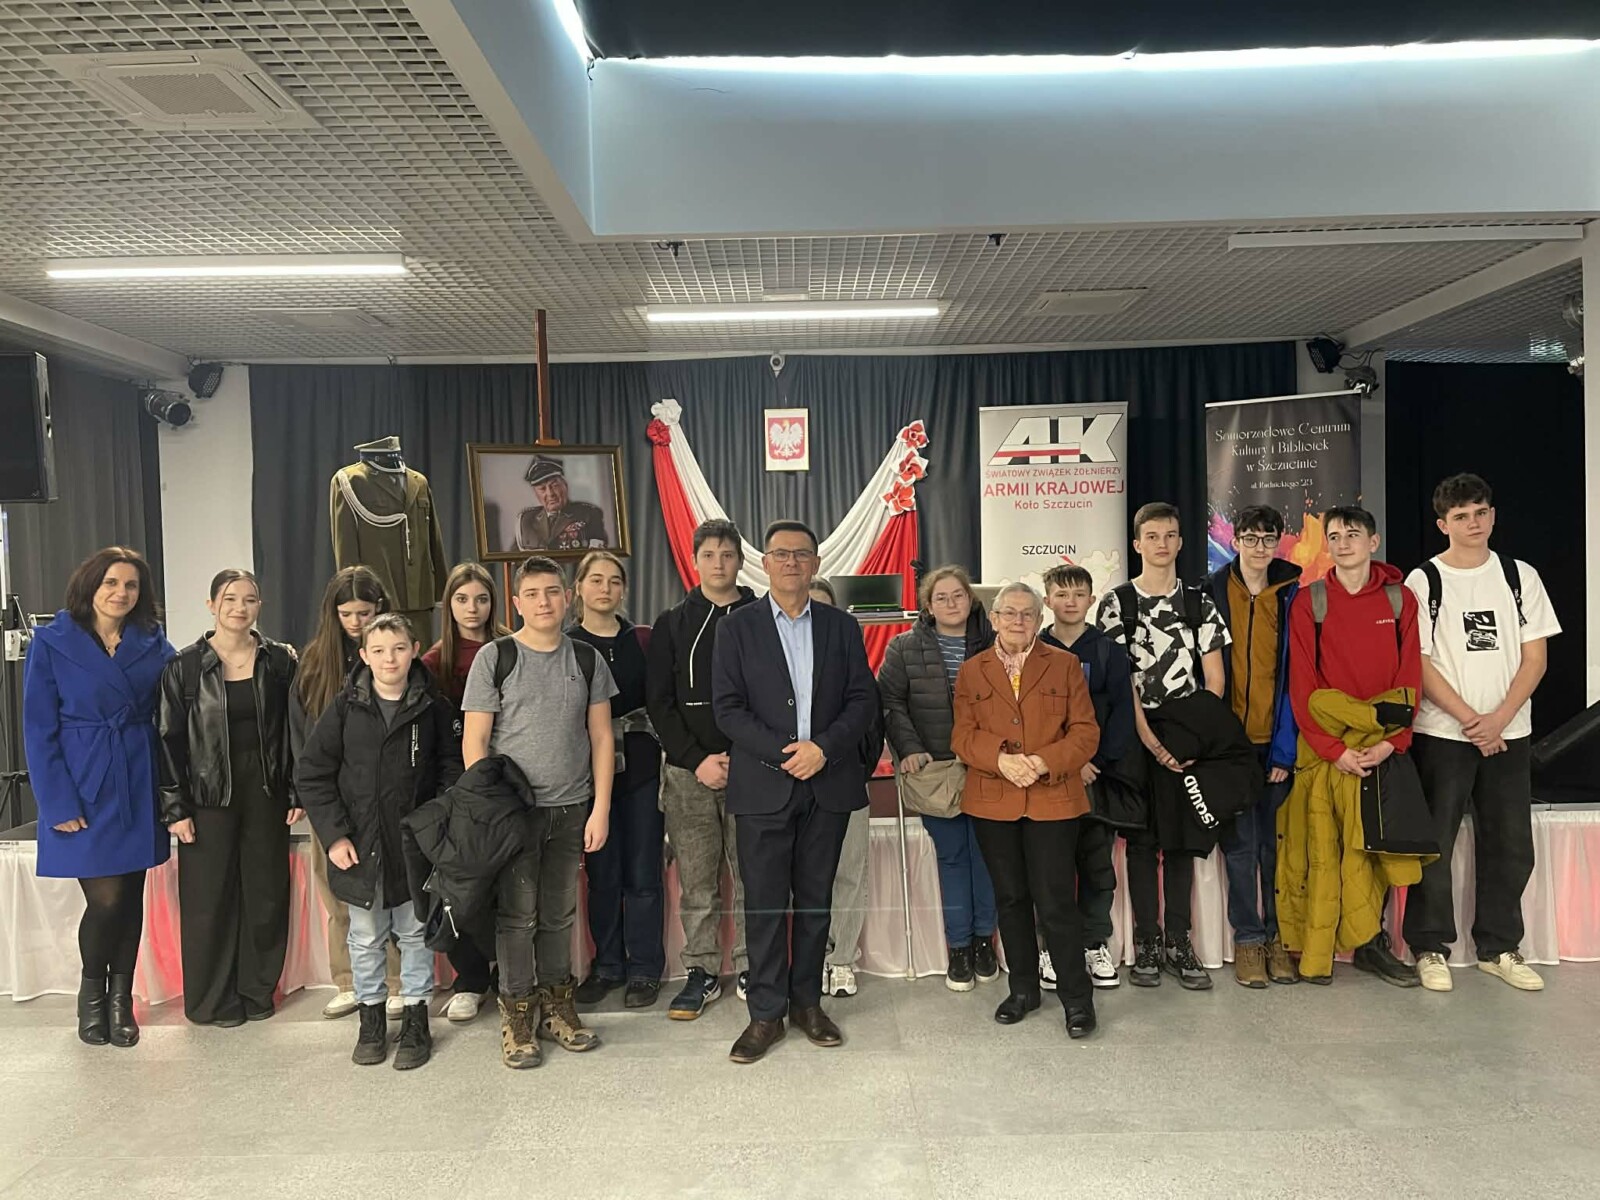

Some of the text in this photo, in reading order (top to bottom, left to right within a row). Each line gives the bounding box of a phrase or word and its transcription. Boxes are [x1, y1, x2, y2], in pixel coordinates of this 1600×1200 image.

[1298, 422, 1351, 435] Centrum
[987, 413, 1123, 466] AK
[1231, 444, 1267, 458] Kultury
[1278, 439, 1329, 453] Bibliotek
[1033, 468, 1071, 478] ZWIĄZEK
[1074, 466, 1122, 476] ŻOŁNIERZY
[1246, 459, 1318, 472] w Szczucinie
[984, 480, 1124, 496] ARMII KRAJOWEJ
[1015, 499, 1093, 510] Koło Szczucin
[1022, 544, 1076, 555] SZCZUCIN
